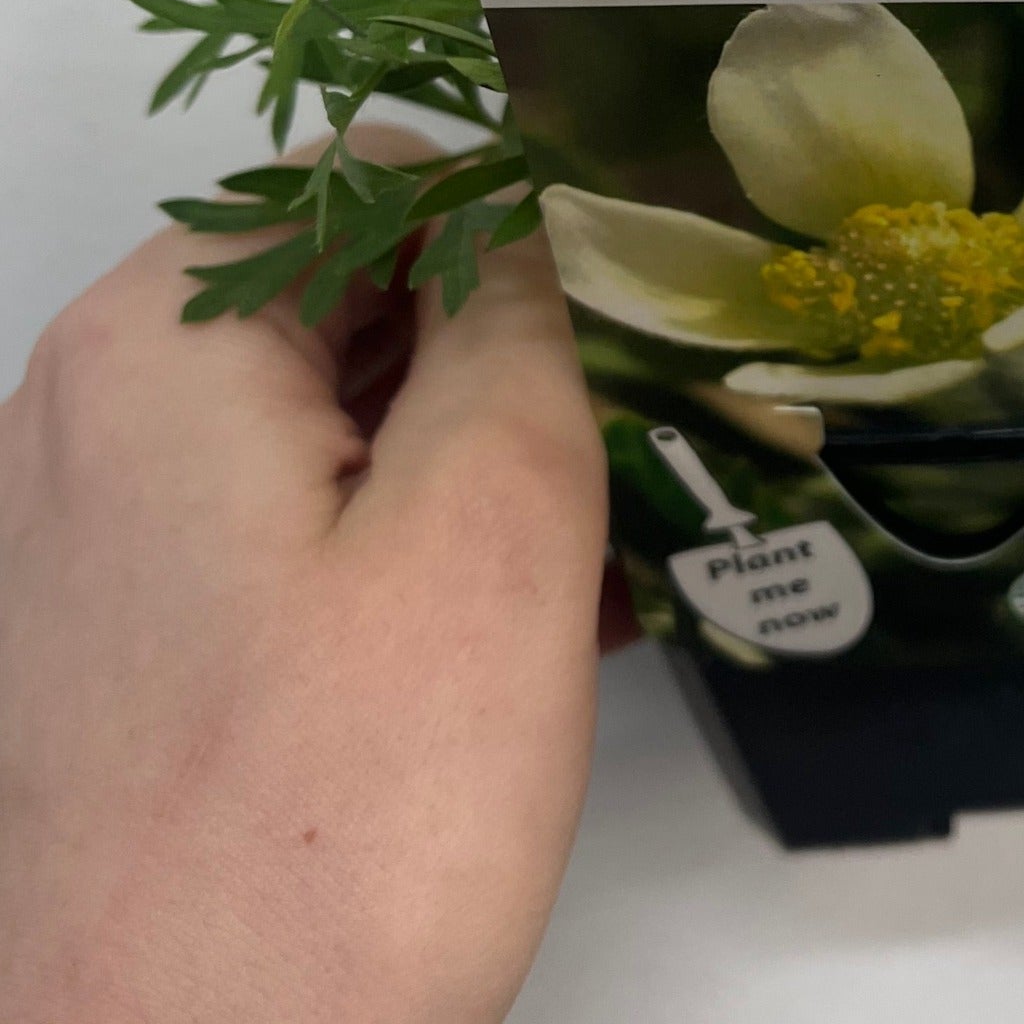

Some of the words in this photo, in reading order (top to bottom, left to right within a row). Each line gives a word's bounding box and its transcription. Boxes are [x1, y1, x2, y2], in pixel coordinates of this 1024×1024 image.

[706, 539, 814, 580] Plant
[751, 578, 809, 604] me
[757, 602, 841, 635] now
